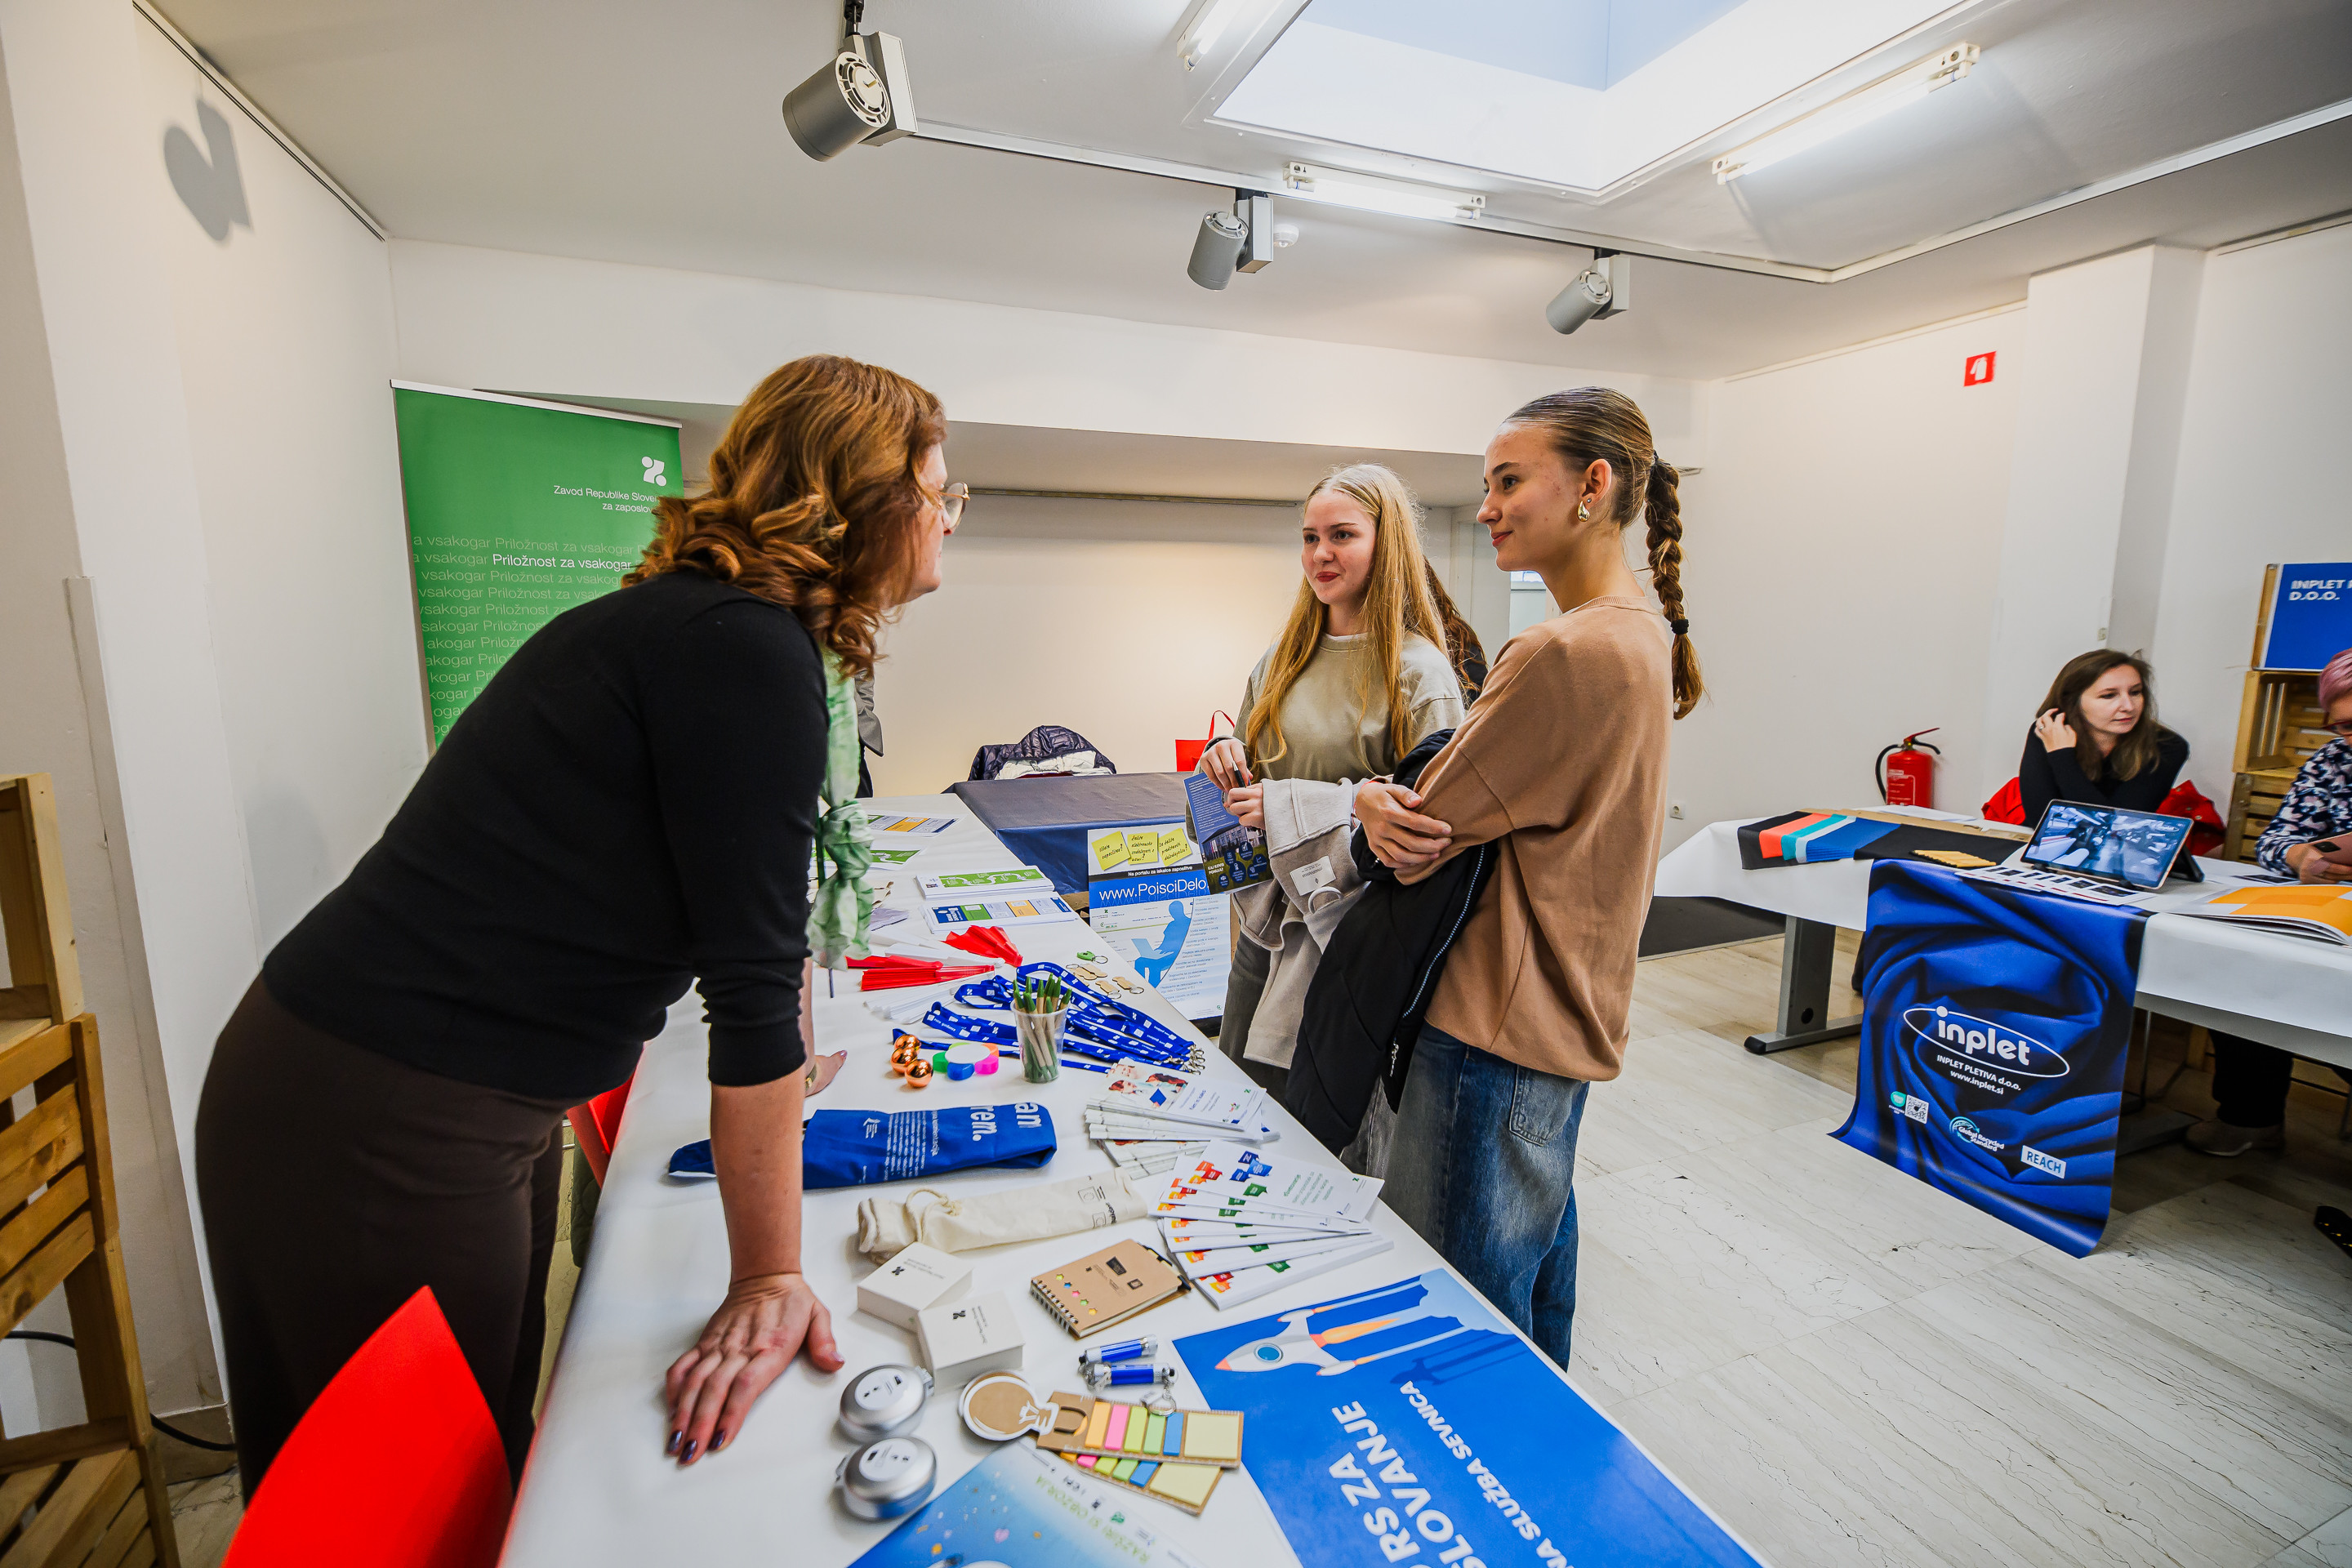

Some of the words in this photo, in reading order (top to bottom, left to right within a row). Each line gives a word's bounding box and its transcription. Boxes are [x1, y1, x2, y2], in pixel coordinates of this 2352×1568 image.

[554, 485, 583, 497] Zavod
[586, 488, 629, 500] Republike
[427, 535, 491, 550] vsakogar
[495, 537, 559, 552] Priložnost
[563, 543, 577, 552] za
[581, 542, 634, 557] vsakogar
[424, 553, 488, 567] vsakogar
[492, 553, 556, 568] Priložnost
[560, 559, 575, 568] za
[578, 557, 632, 572] vsakogar
[421, 570, 486, 584] vsakogar
[490, 570, 555, 583] Priložnost
[558, 574, 572, 583] za
[2290, 579, 2346, 590] INPLET
[419, 586, 483, 601] vsakogar
[488, 587, 551, 599] Priložnost
[555, 590, 571, 599] za
[2288, 590, 2341, 601] D.O.O.
[485, 604, 549, 615] Priložnost
[422, 620, 478, 635] sakogar
[427, 637, 476, 652] akogar
[430, 672, 471, 685] kogar
[1936, 1005, 2030, 1066] inplet
[1936, 1054, 1964, 1070] INPLET
[1964, 1063, 1997, 1082] PLETIVA
[1950, 1070, 2004, 1095] www.inplet.si
[1958, 1125, 1978, 1139] Global
[2026, 1150, 2062, 1174] REACH
[1400, 1380, 1472, 1460] SEVNICA
[1329, 1451, 1382, 1508] ZA
[1467, 1457, 1541, 1541] SLUŽBA
[1363, 1507, 1421, 1563] RS
